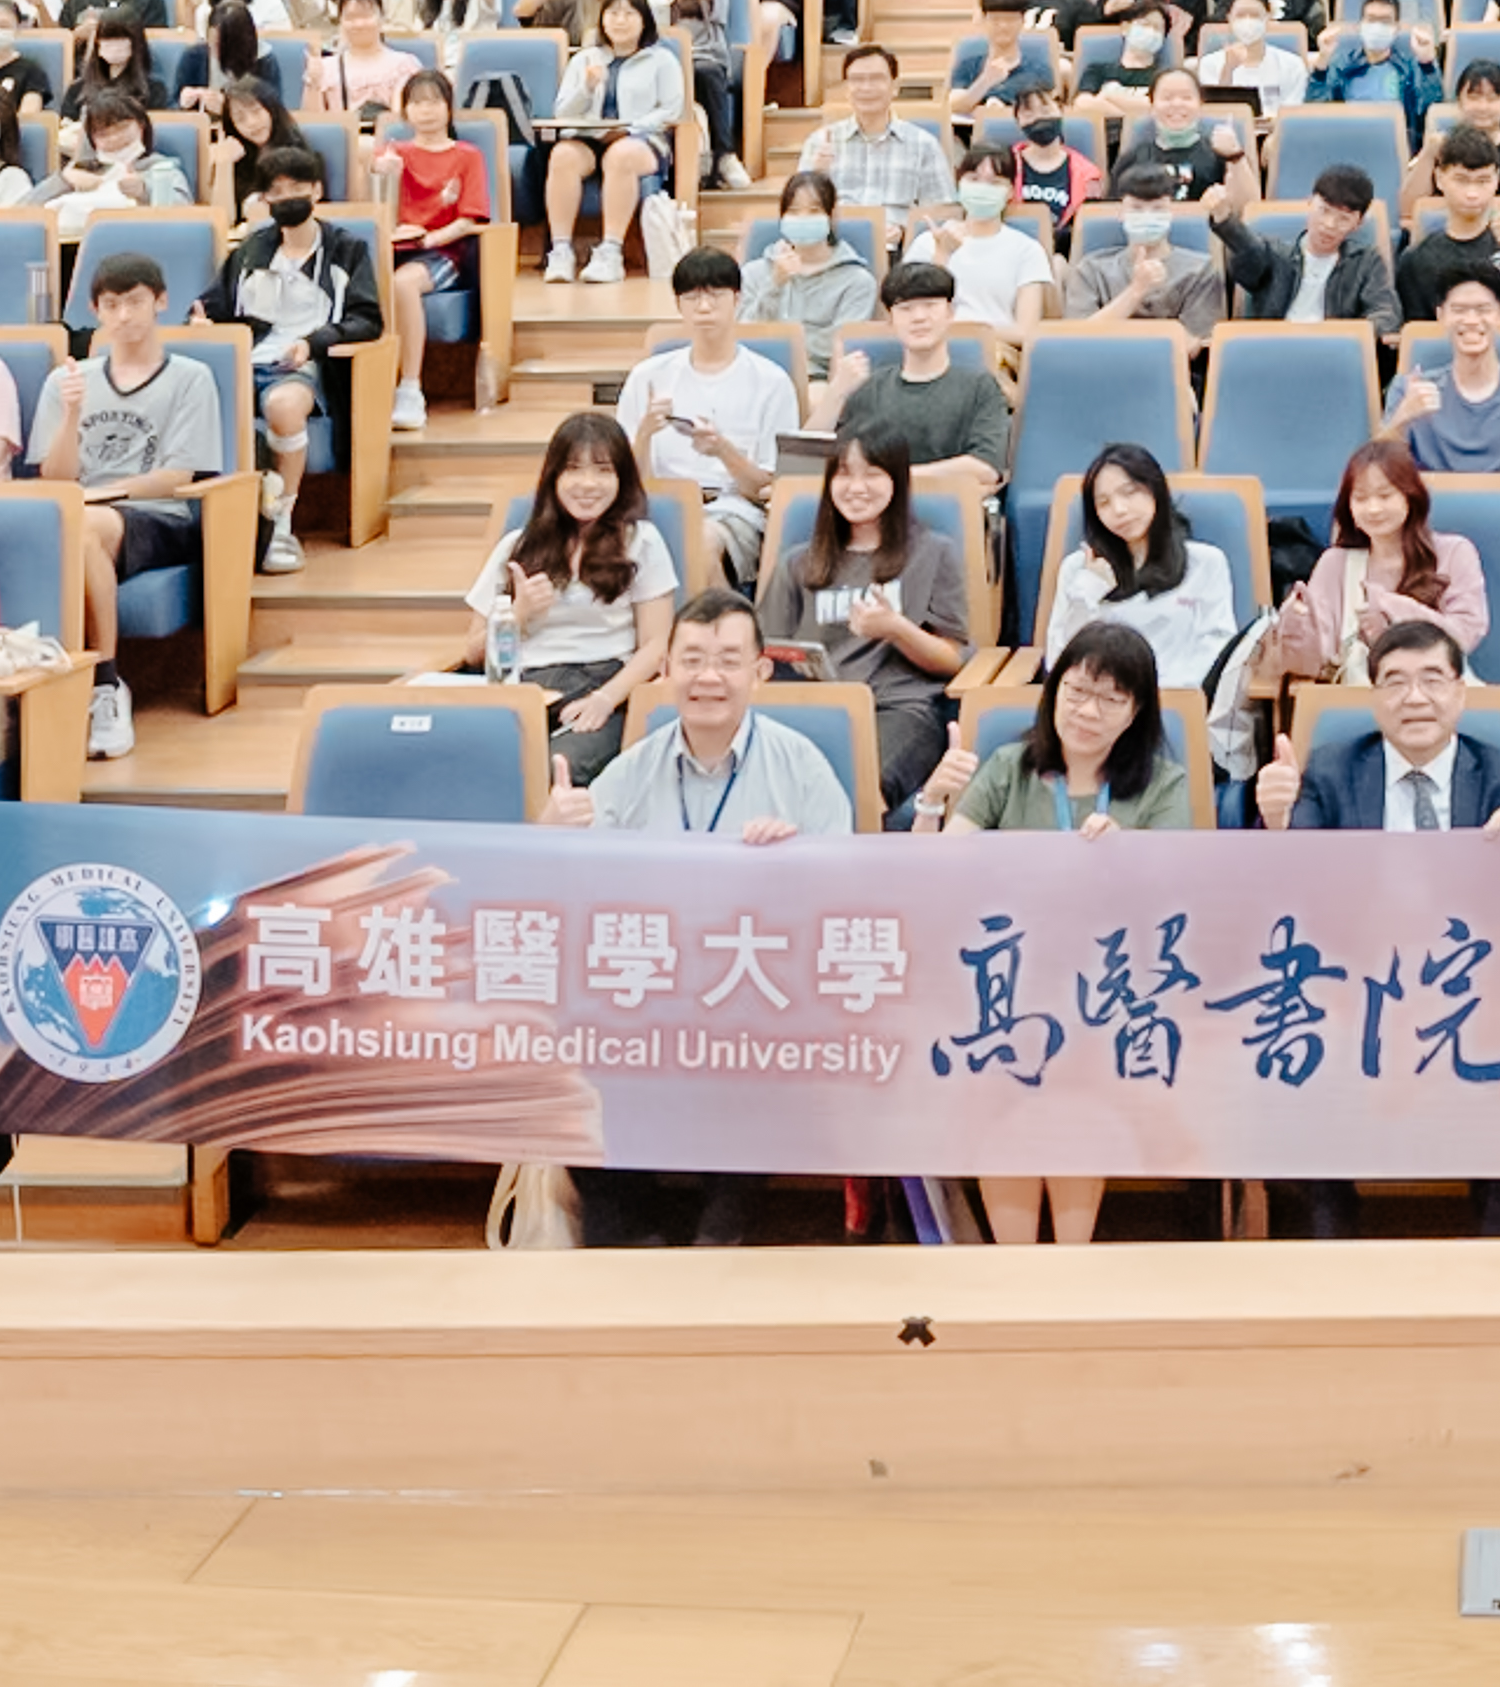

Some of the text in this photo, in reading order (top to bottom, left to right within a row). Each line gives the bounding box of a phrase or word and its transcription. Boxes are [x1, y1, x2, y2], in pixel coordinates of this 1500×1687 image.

[246, 904, 908, 1013] 高雄醫學大學
[241, 1014, 901, 1081] Kaohsiung Medical University
